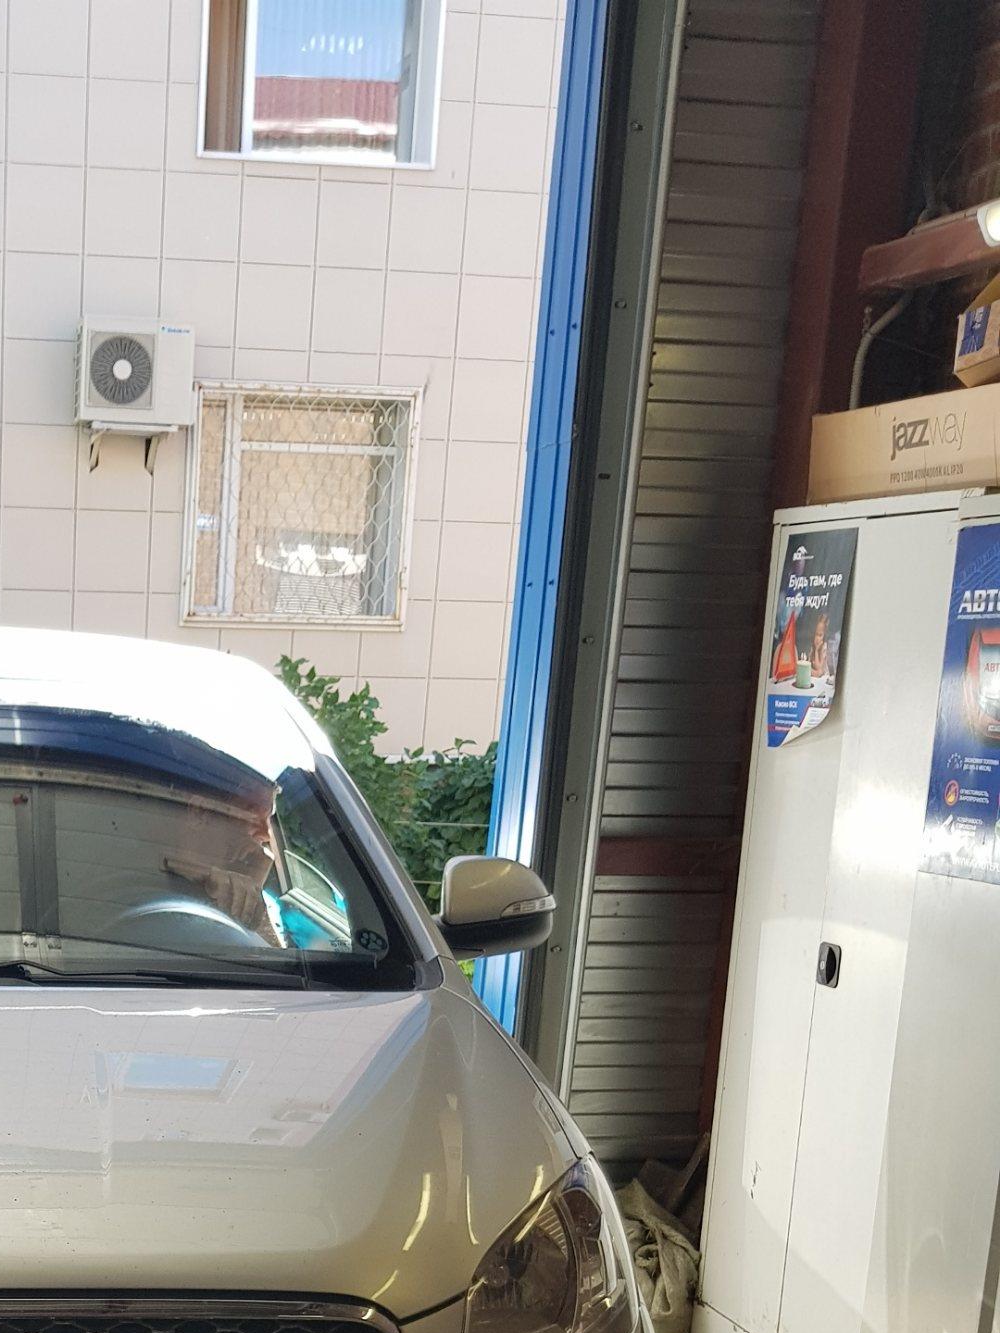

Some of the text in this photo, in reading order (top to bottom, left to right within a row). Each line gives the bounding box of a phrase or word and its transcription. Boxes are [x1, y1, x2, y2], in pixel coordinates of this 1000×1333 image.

[890, 411, 967, 461] jazzway
[788, 573, 843, 590] Будь там, где
[785, 592, 829, 609] тебя ждут!
[958, 588, 1000, 613] АВТ
